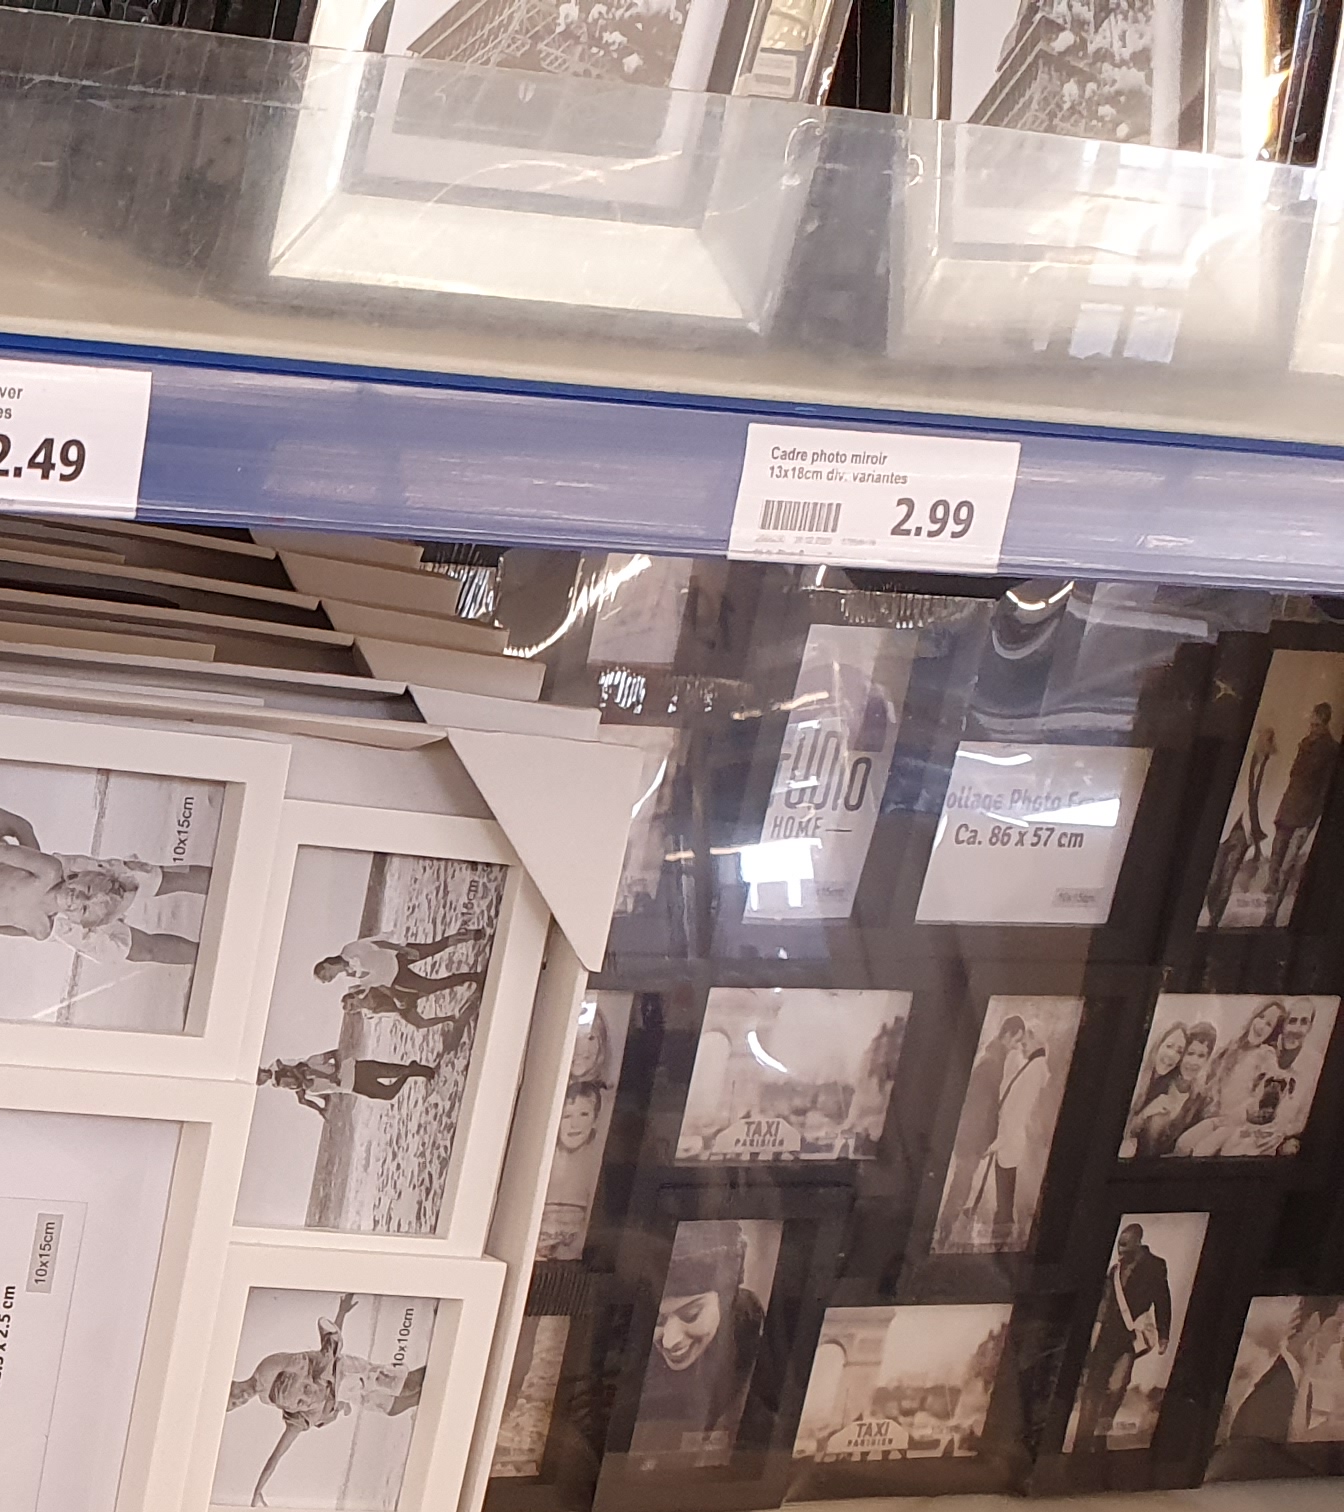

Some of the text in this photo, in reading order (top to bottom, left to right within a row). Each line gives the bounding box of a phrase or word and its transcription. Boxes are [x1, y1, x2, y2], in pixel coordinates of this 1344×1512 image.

[771, 446, 888, 466] Cadre photo miroir
[768, 465, 908, 485] 13x18cm div. variantes
[890, 497, 975, 539] 2.99
[947, 786, 1005, 811] ollage
[1009, 789, 1062, 811] Photo
[171, 795, 195, 864] 10x15cm
[955, 823, 1084, 848] Ca. 86 x 57 cm
[745, 1121, 780, 1137] TAXI
[35, 1221, 56, 1285] 10x15cm
[3, 1285, 16, 1310] cm
[392, 1307, 414, 1369] 10x10cm
[856, 1421, 890, 1438] TAXI
